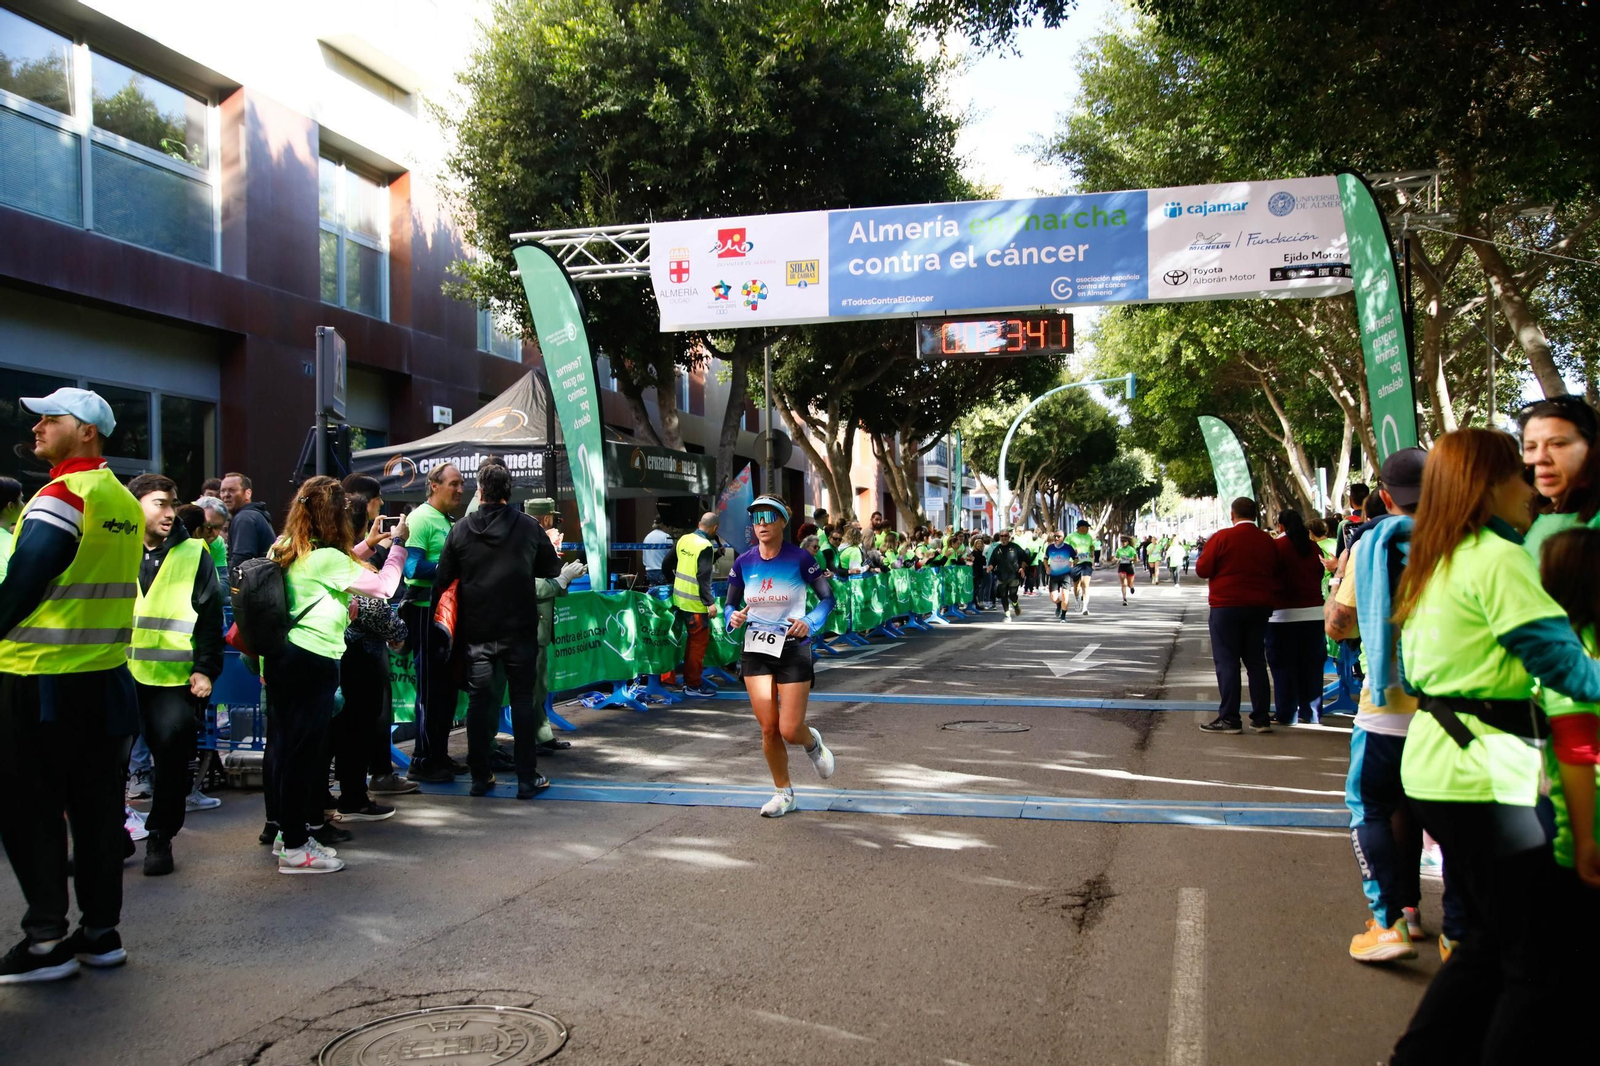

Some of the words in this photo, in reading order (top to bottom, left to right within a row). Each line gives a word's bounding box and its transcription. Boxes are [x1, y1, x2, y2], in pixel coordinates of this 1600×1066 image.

[1187, 201, 1248, 217] cajamar
[848, 215, 960, 244] Almería
[969, 216, 1003, 235] en
[1015, 204, 1128, 232] marcha
[1247, 231, 1319, 247] Fundación
[848, 250, 941, 276] contra
[950, 245, 977, 269] el
[986, 242, 1089, 268] cáncer
[1284, 252, 1309, 264] Ejido
[1312, 251, 1343, 260] Motor
[790, 262, 816, 273] SOLAN
[1193, 267, 1222, 275] Toyota
[1076, 275, 1110, 283] asociación
[1193, 275, 1227, 285] Alborán
[1229, 273, 1256, 282] Motor
[660, 286, 699, 298] ALMERÍA
[841, 295, 933, 307] #TodosContraElCáncer
[752, 630, 776, 645] 746
